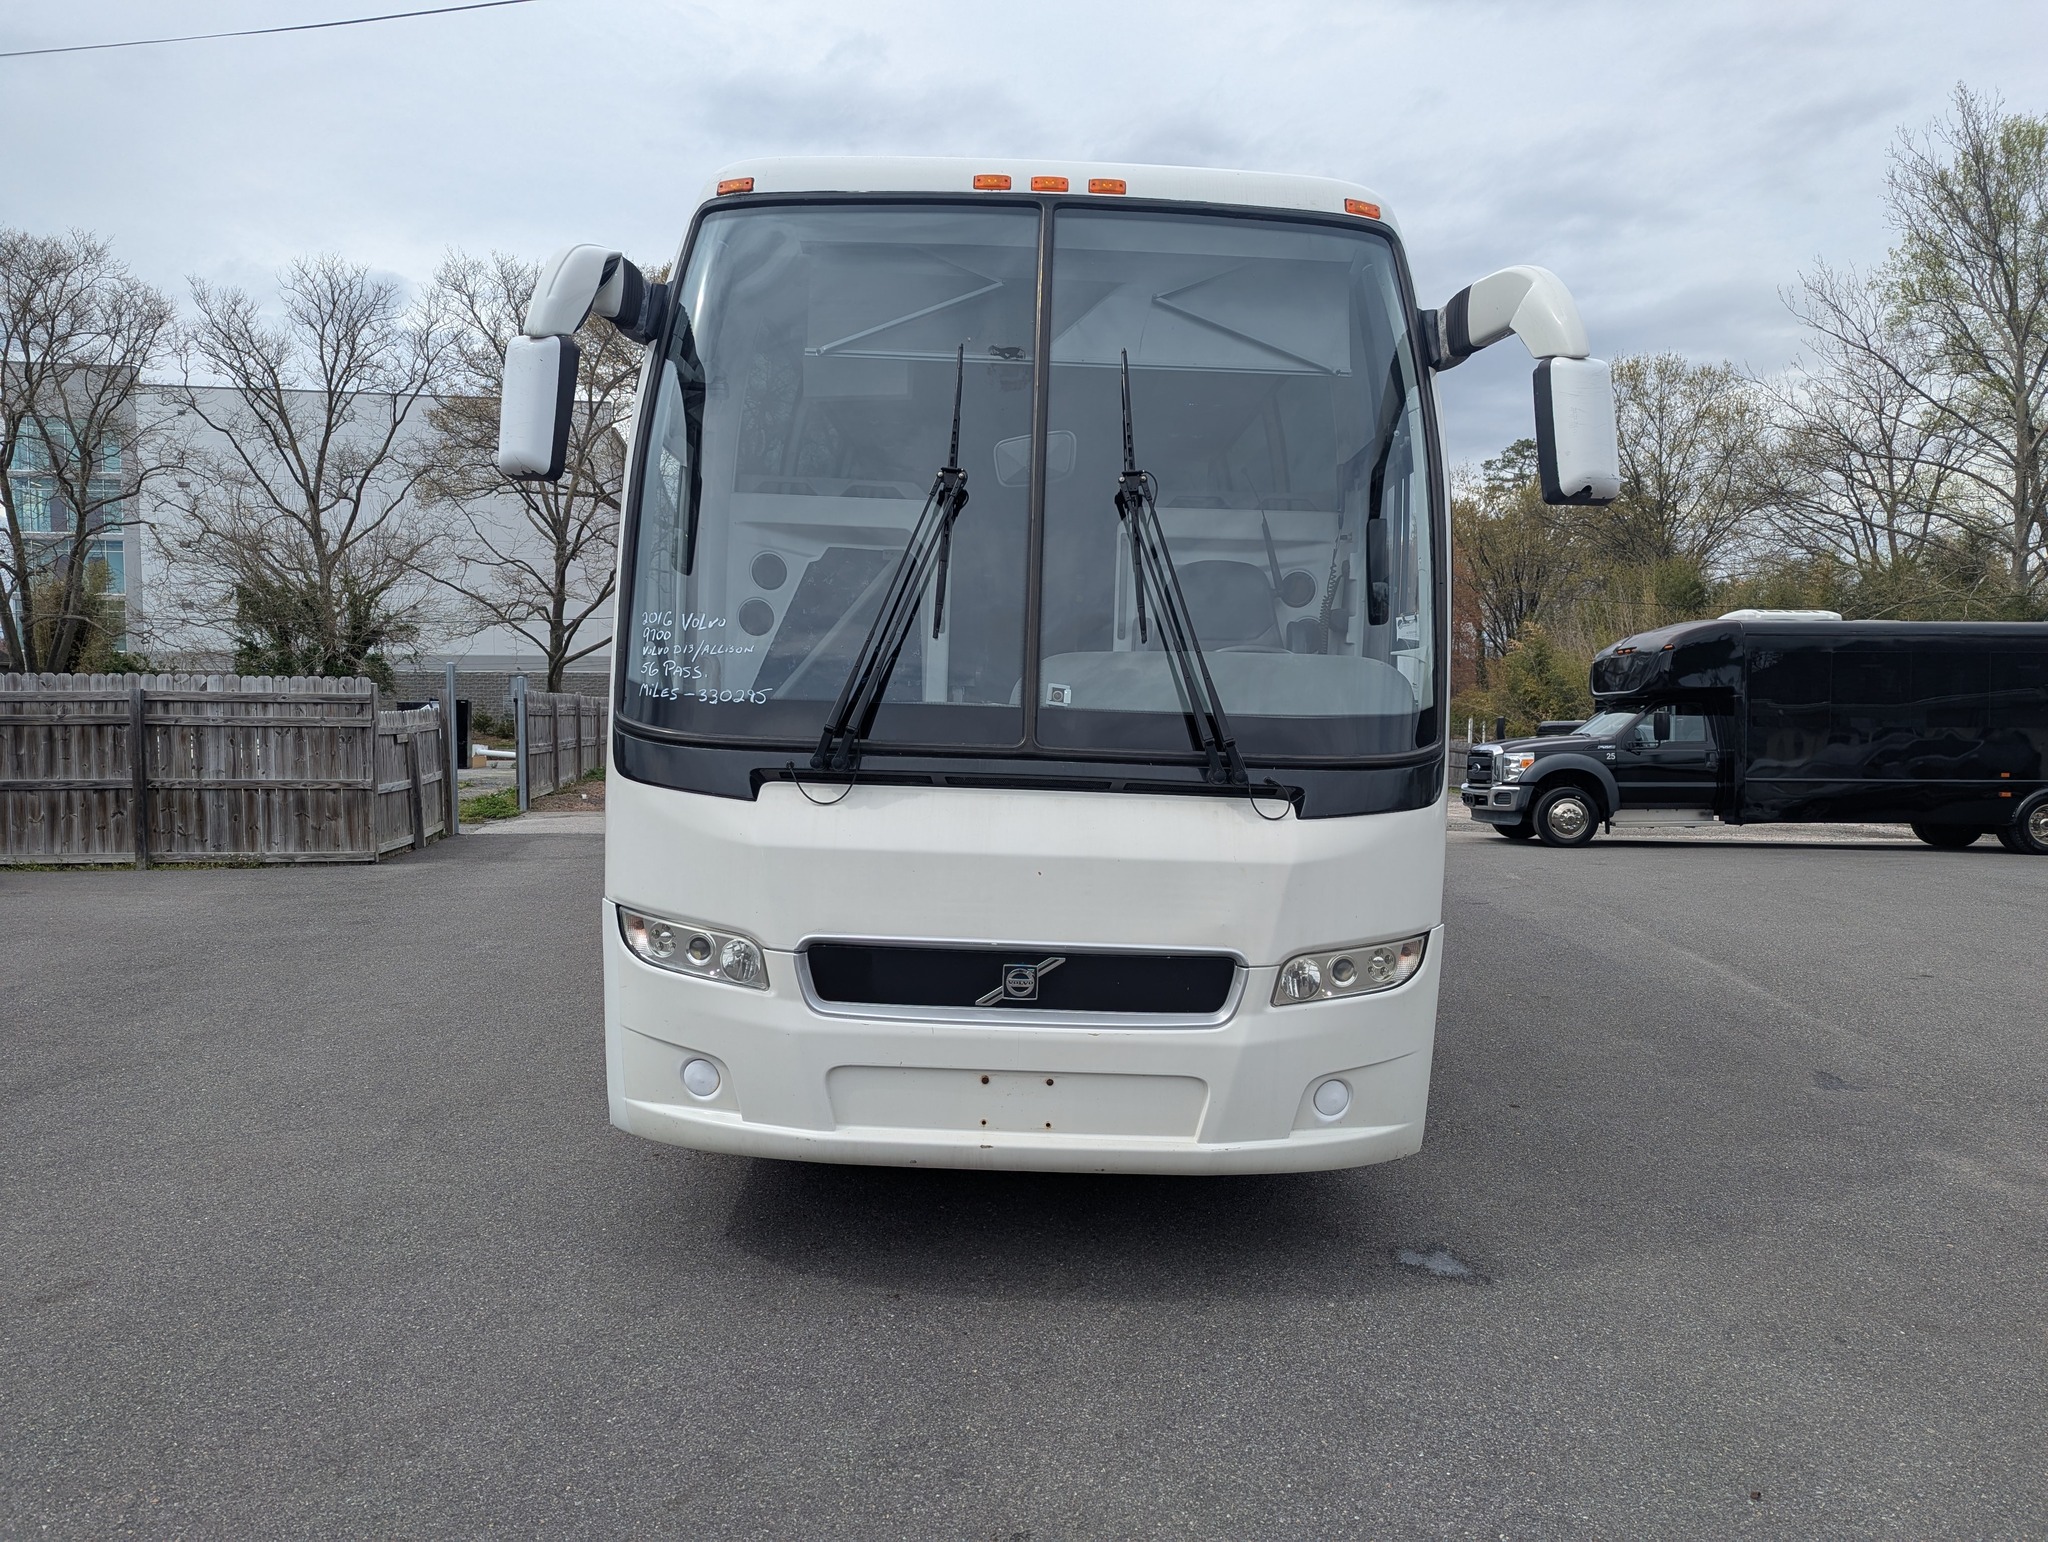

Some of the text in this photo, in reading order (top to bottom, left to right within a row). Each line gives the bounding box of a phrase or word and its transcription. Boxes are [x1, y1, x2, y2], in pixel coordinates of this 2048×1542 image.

[641, 611, 673, 626] 2016
[643, 627, 672, 642] 9700
[641, 661, 659, 676] 56
[1606, 752, 1616, 760] 25
